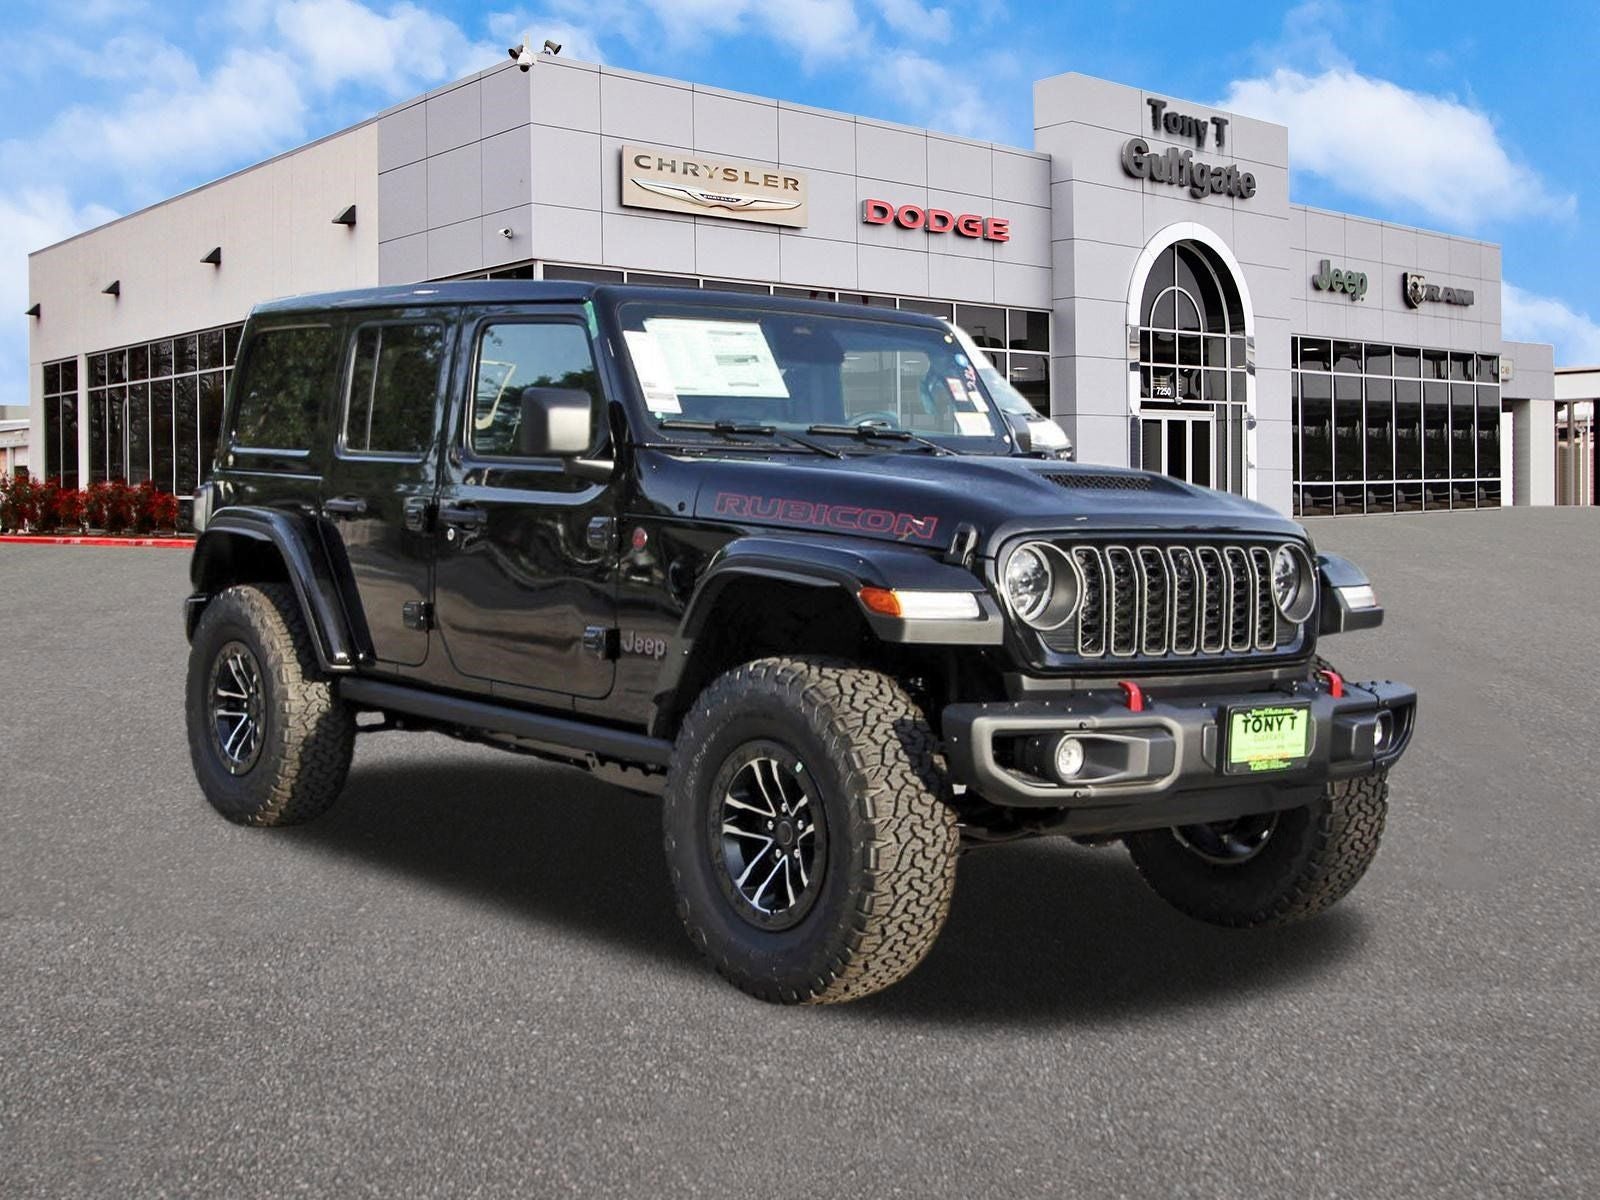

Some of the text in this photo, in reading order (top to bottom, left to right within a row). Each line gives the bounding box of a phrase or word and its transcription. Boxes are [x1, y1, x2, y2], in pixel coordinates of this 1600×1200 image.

[1146, 97, 1229, 147] Tony T
[633, 154, 801, 193] CHRYSLER
[1121, 137, 1257, 199] Gulfgate
[862, 198, 1011, 242] DODGE
[1312, 259, 1368, 302] Jeep
[1424, 283, 1475, 306] RAM
[1156, 387, 1172, 396] 7250
[715, 492, 938, 539] RUBICON
[623, 630, 666, 659] Jeep
[1242, 715, 1298, 733] TONY T
